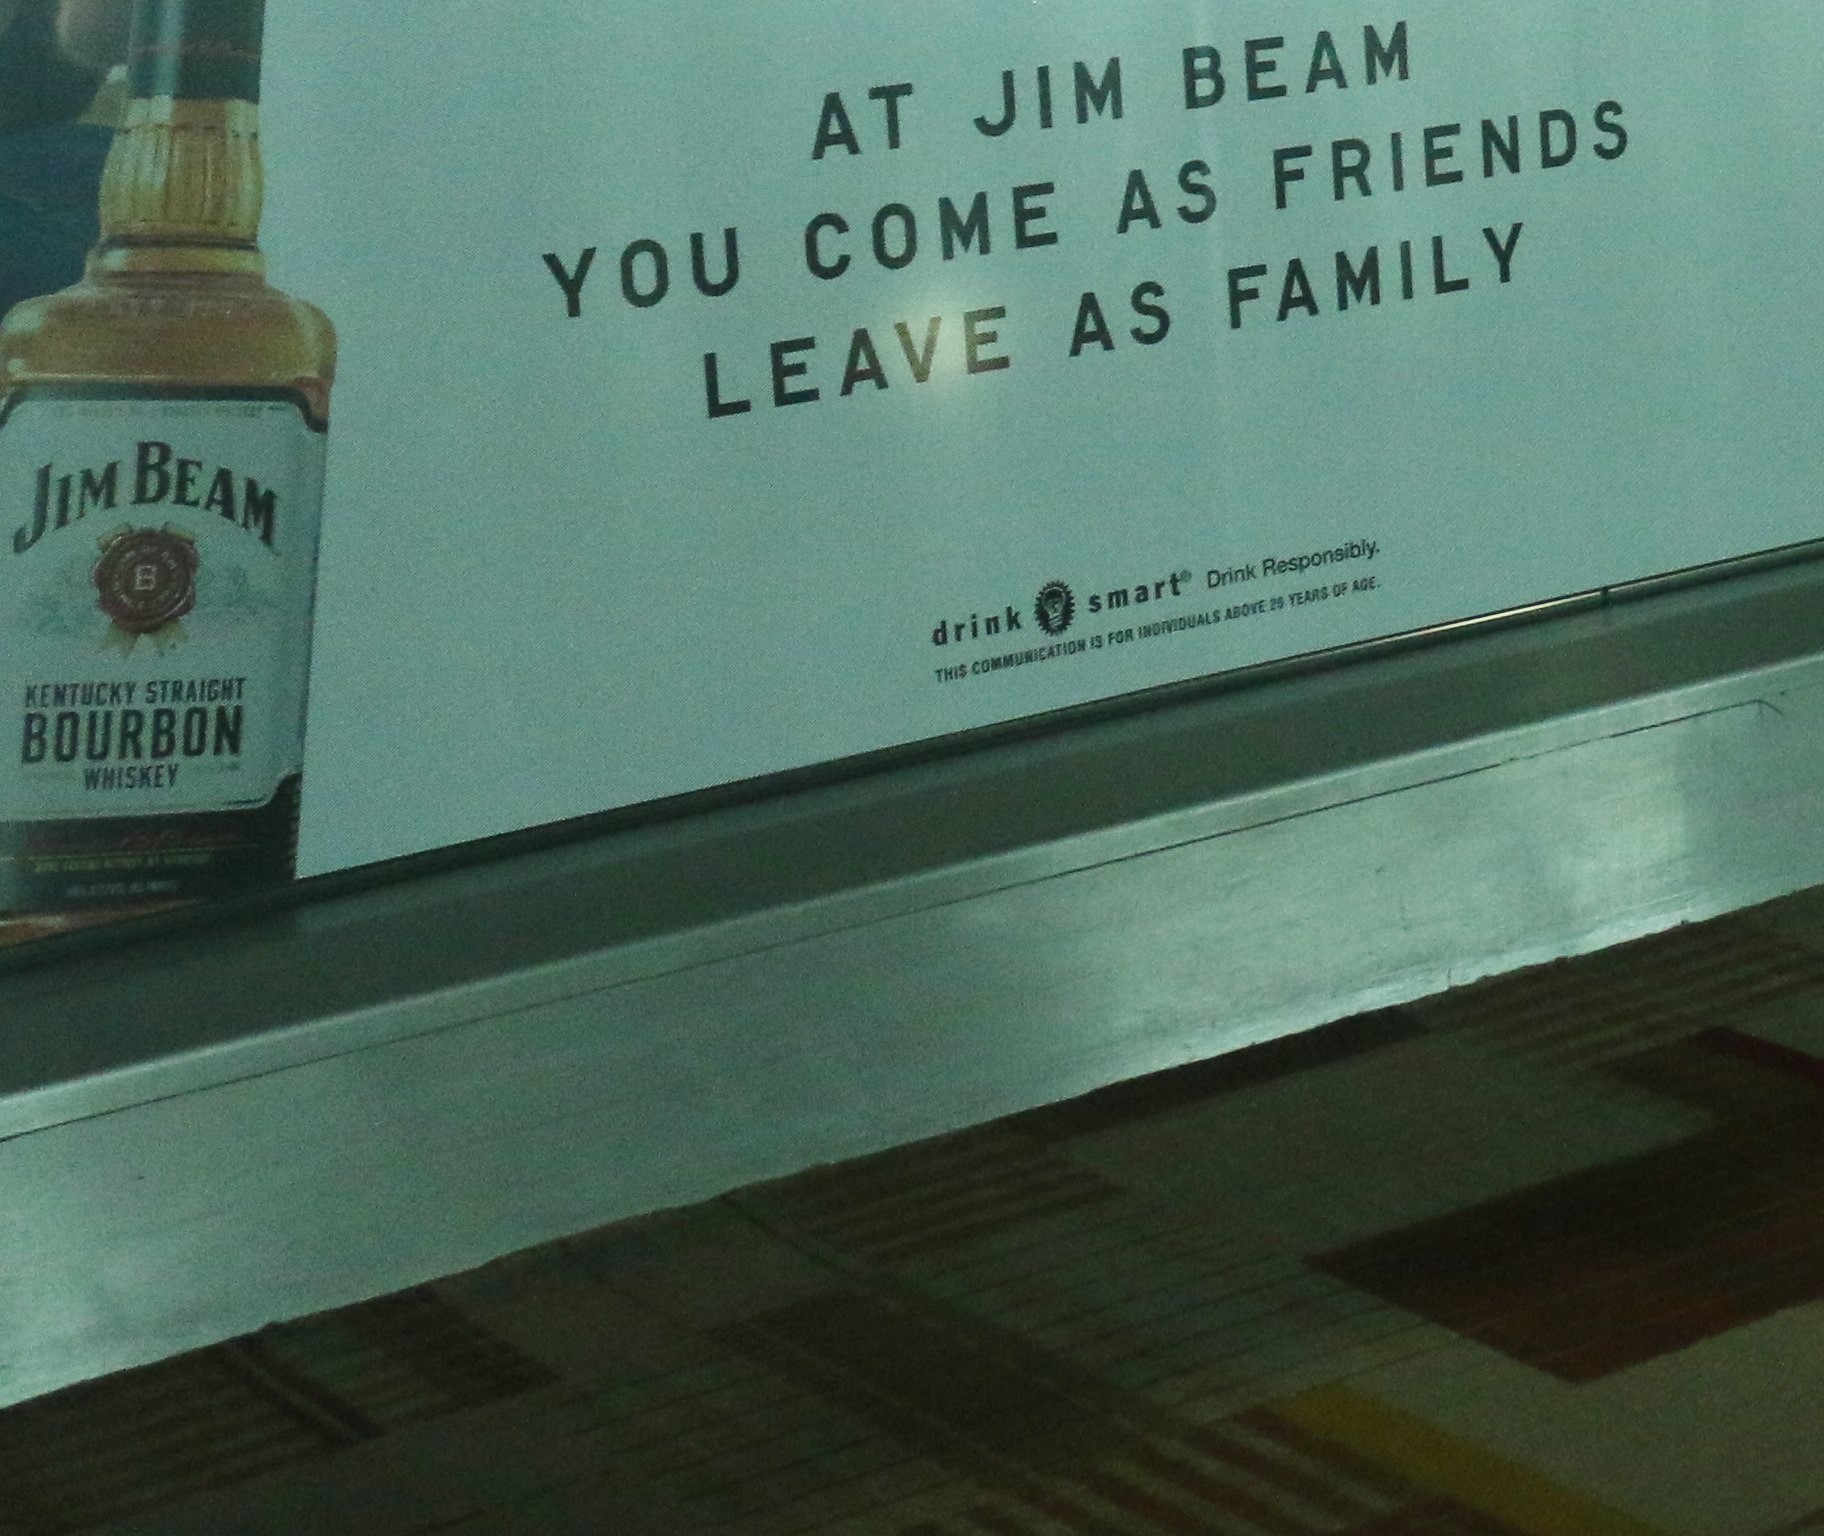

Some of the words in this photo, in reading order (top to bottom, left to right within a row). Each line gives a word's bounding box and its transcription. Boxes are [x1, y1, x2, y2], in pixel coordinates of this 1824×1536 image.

[811, 82, 913, 160] AT
[972, 56, 1125, 140] JIM
[1182, 20, 1412, 111] BEAM
[542, 227, 742, 319] YOU
[804, 181, 1060, 281] COME
[1115, 159, 1219, 236] AS
[1272, 100, 1629, 211] FRIENDS
[703, 305, 1012, 420] LEAVE
[1067, 279, 1173, 358] AS
[1226, 222, 1524, 331] FAMILY
[12, 460, 122, 554] JIM
[130, 440, 279, 548] BEAM
[931, 605, 1023, 647] drink
[1206, 563, 1257, 590] Drink
[1262, 538, 1381, 577] Responsibly.
[934, 664, 968, 683] THIS
[970, 637, 1087, 676] COMMUNICATION
[1089, 635, 1104, 650] IS
[1107, 628, 1135, 646] FOR
[1137, 609, 1221, 641] INDIVIDUALS
[1224, 598, 1266, 621] ABOVE
[1287, 585, 1329, 607] YEARS
[1332, 581, 1348, 598] OF
[21, 704, 245, 765] BOURBON
[24, 680, 137, 708] KENTUCKY
[144, 676, 248, 705] STRAIGHT
[83, 763, 182, 792] WHISKEY
